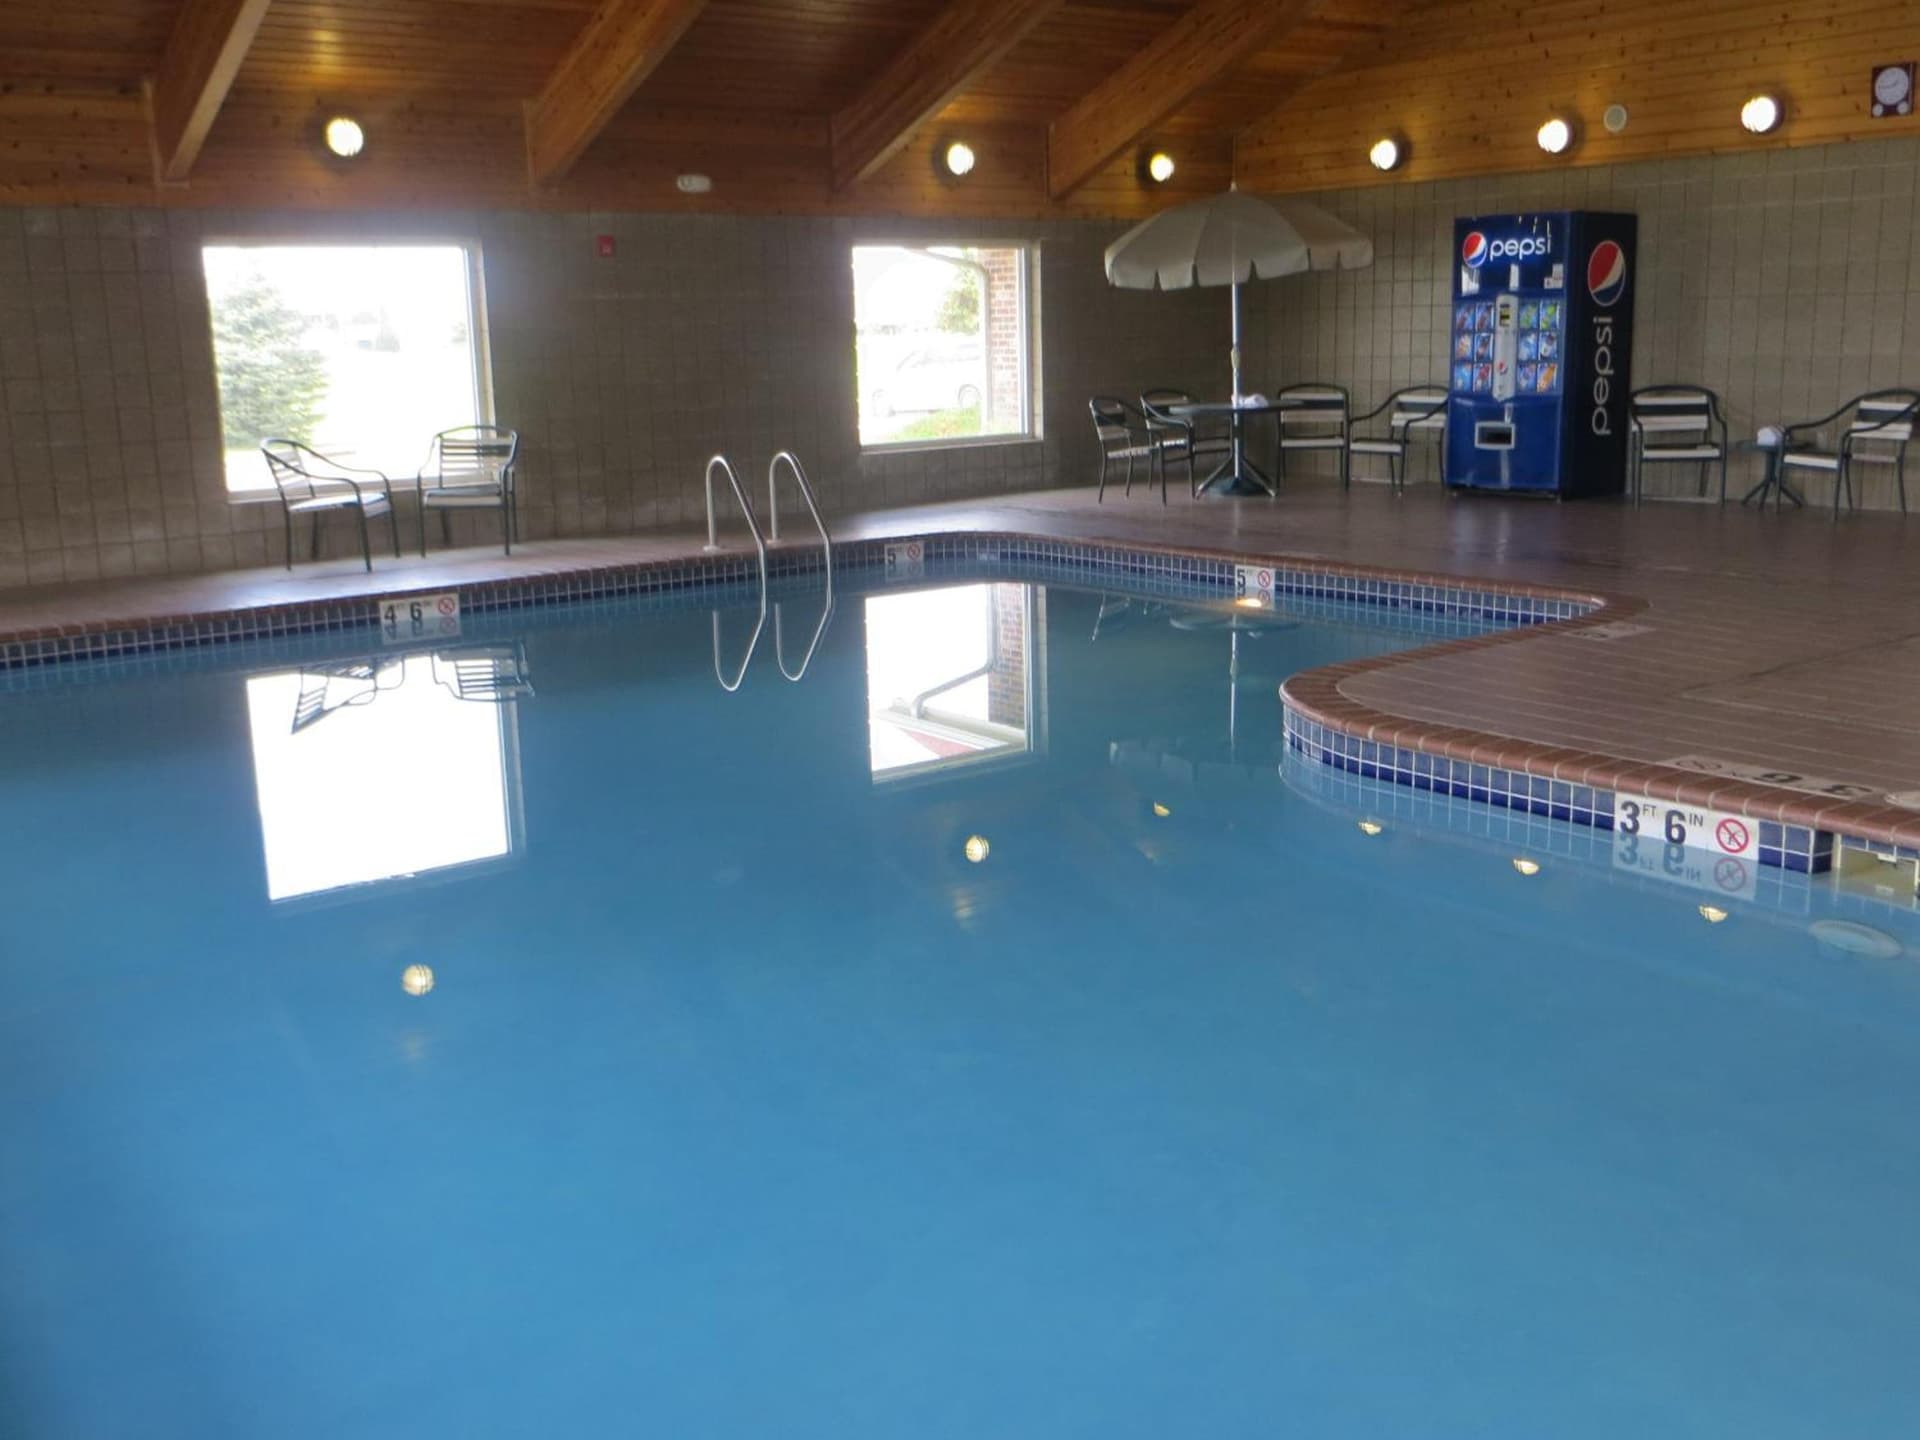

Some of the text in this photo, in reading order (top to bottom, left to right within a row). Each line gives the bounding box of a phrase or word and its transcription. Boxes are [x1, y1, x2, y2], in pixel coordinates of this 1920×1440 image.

[1489, 235, 1552, 262] pepsi
[1591, 316, 1615, 436] pepsi
[886, 547, 897, 566] 5
[1236, 568, 1246, 588] 5
[384, 602, 422, 624] 4 6
[1620, 801, 1704, 845] 3 FT 6 IN
